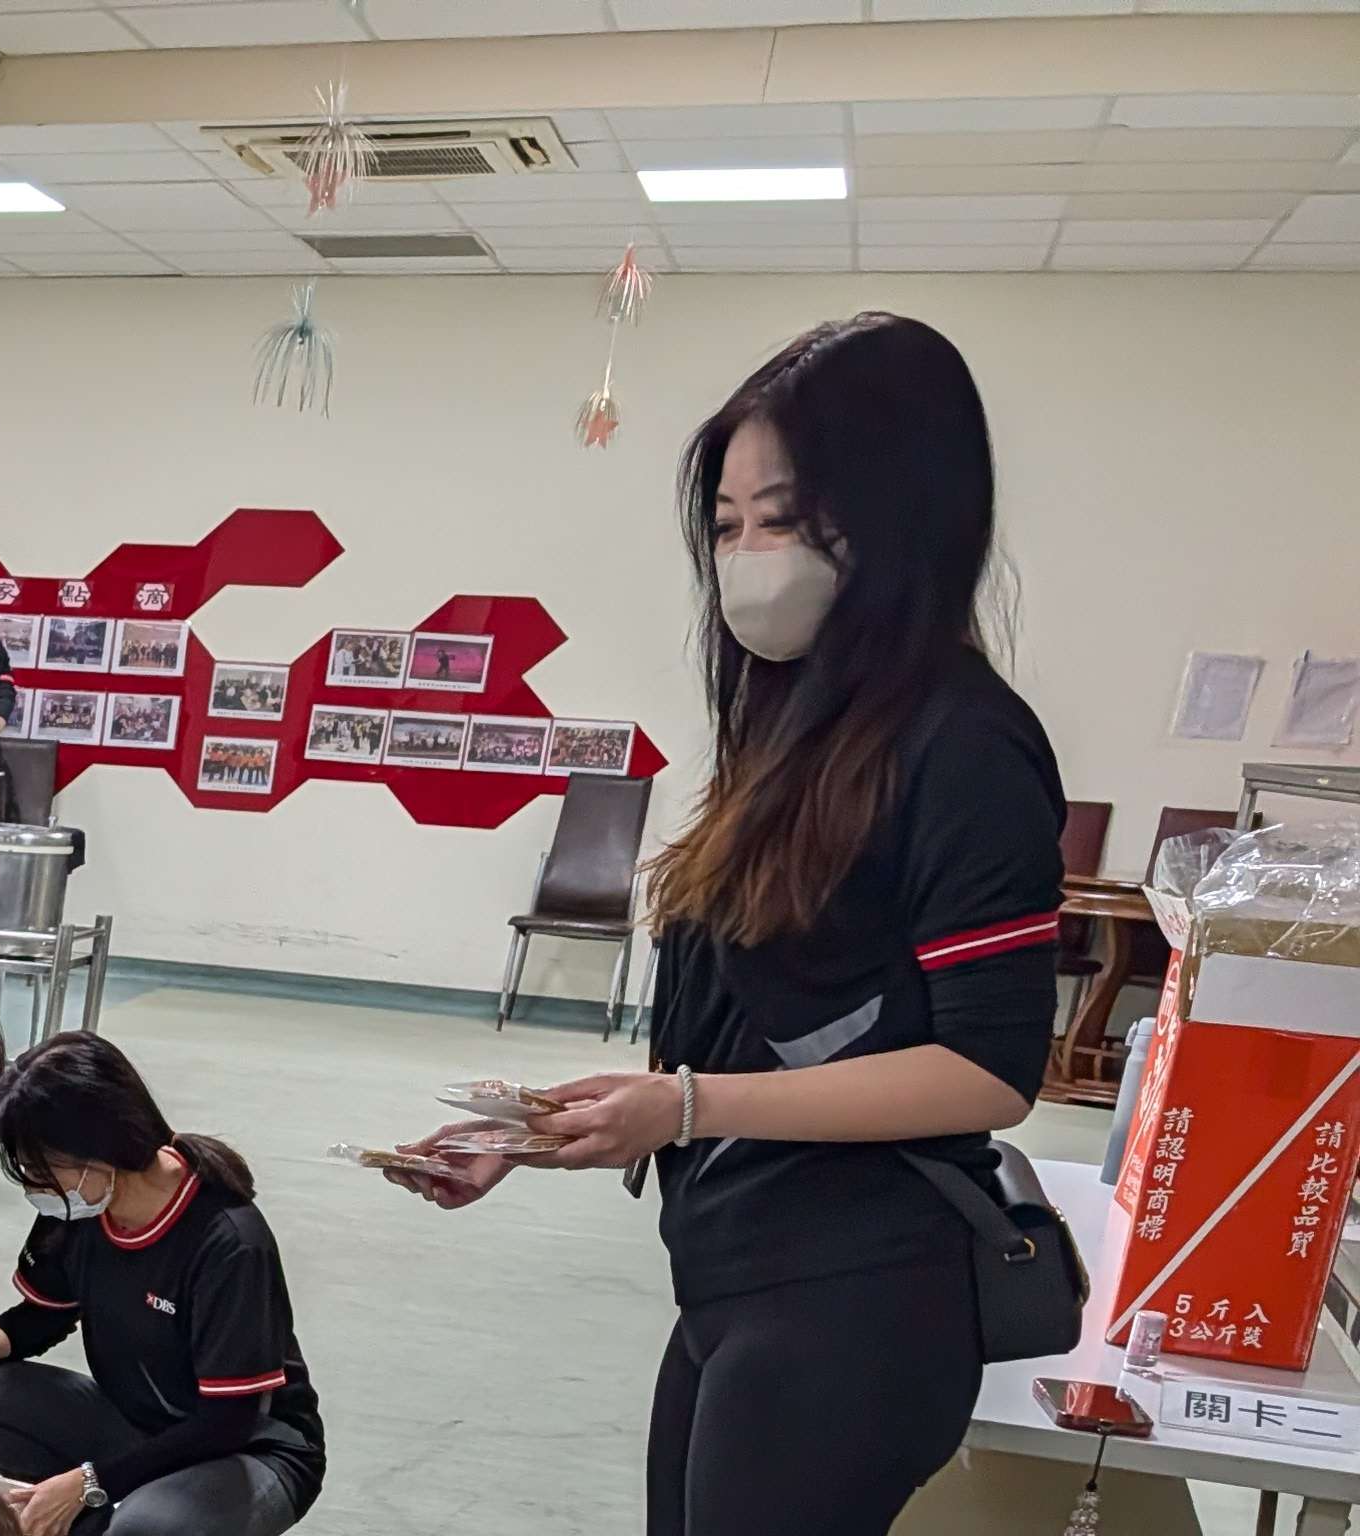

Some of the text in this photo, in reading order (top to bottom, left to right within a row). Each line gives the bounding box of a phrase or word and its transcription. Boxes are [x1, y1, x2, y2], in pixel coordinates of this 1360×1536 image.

[1137, 1106, 1194, 1240] 請認明商標
[1286, 1121, 1347, 1259] 請比較品質
[1169, 1317, 1264, 1348] 3公斤裝
[1185, 1391, 1342, 1438] 關卡二
